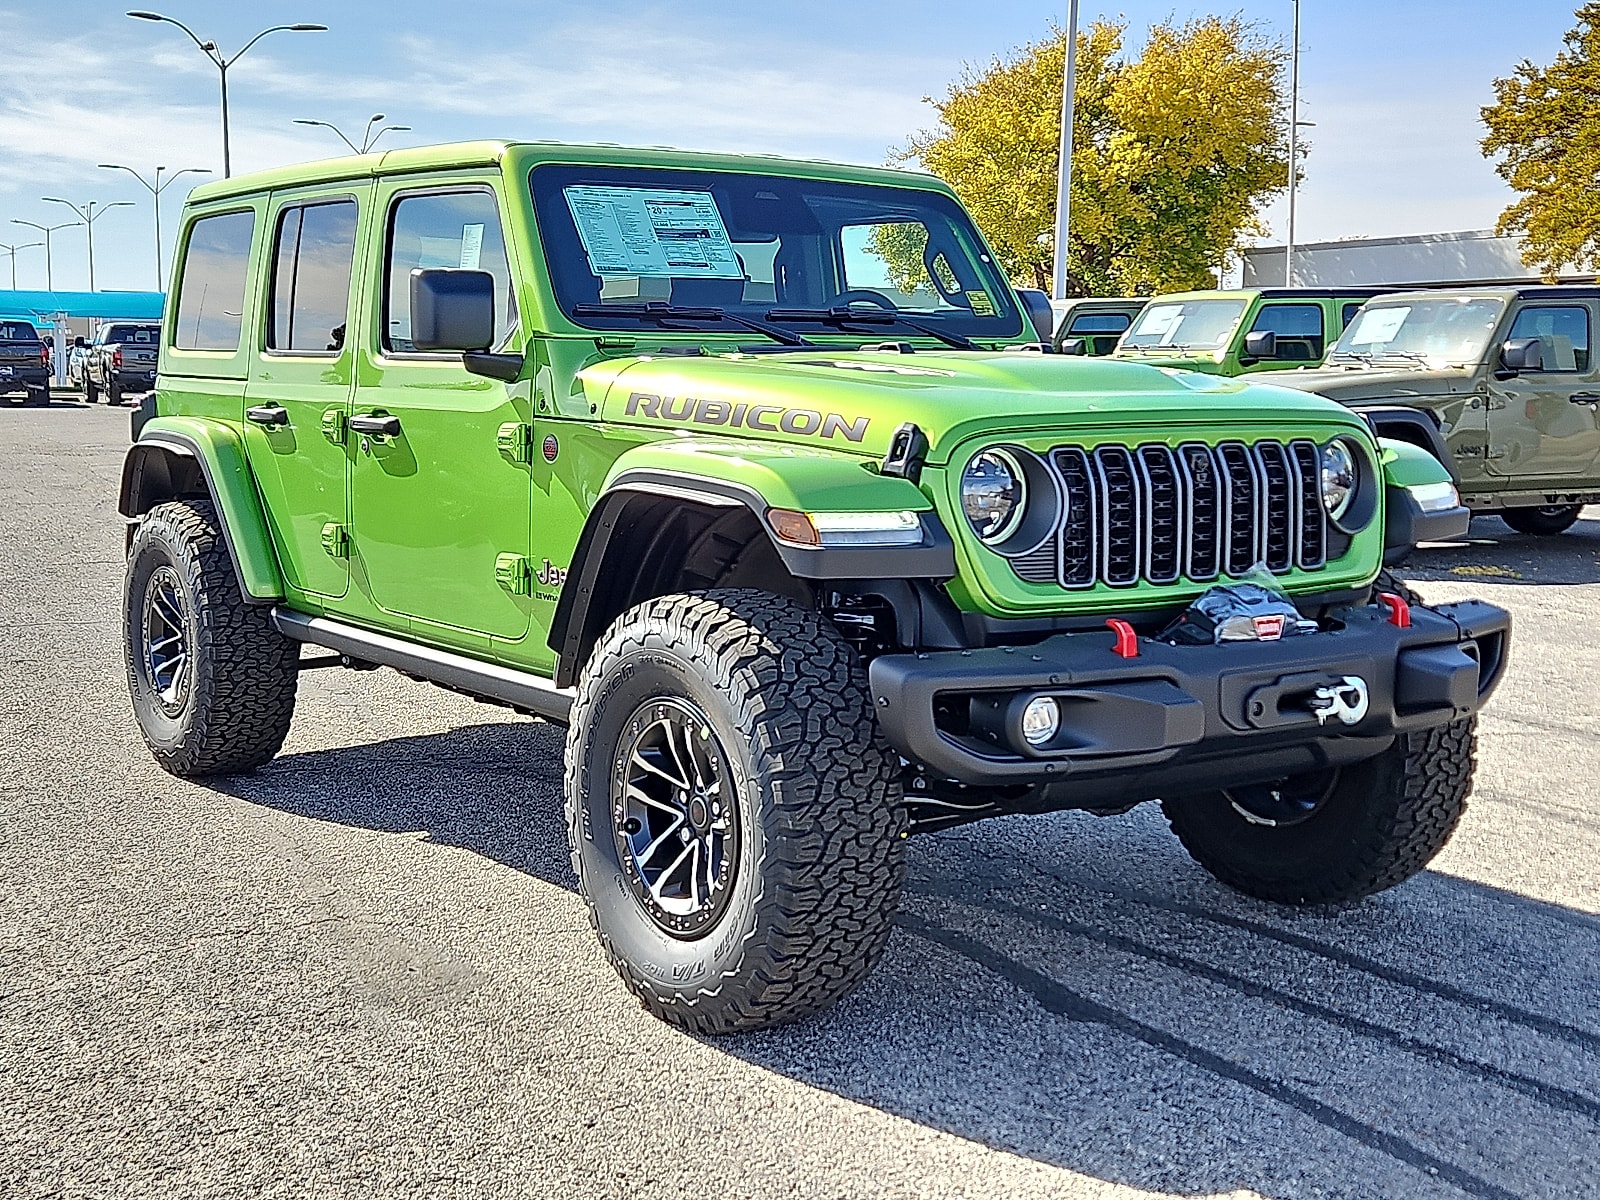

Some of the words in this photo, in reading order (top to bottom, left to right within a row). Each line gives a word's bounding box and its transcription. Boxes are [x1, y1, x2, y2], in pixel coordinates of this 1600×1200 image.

[624, 392, 871, 442] RUBICON
[536, 558, 567, 587] Jee
[672, 960, 706, 981] T/A
